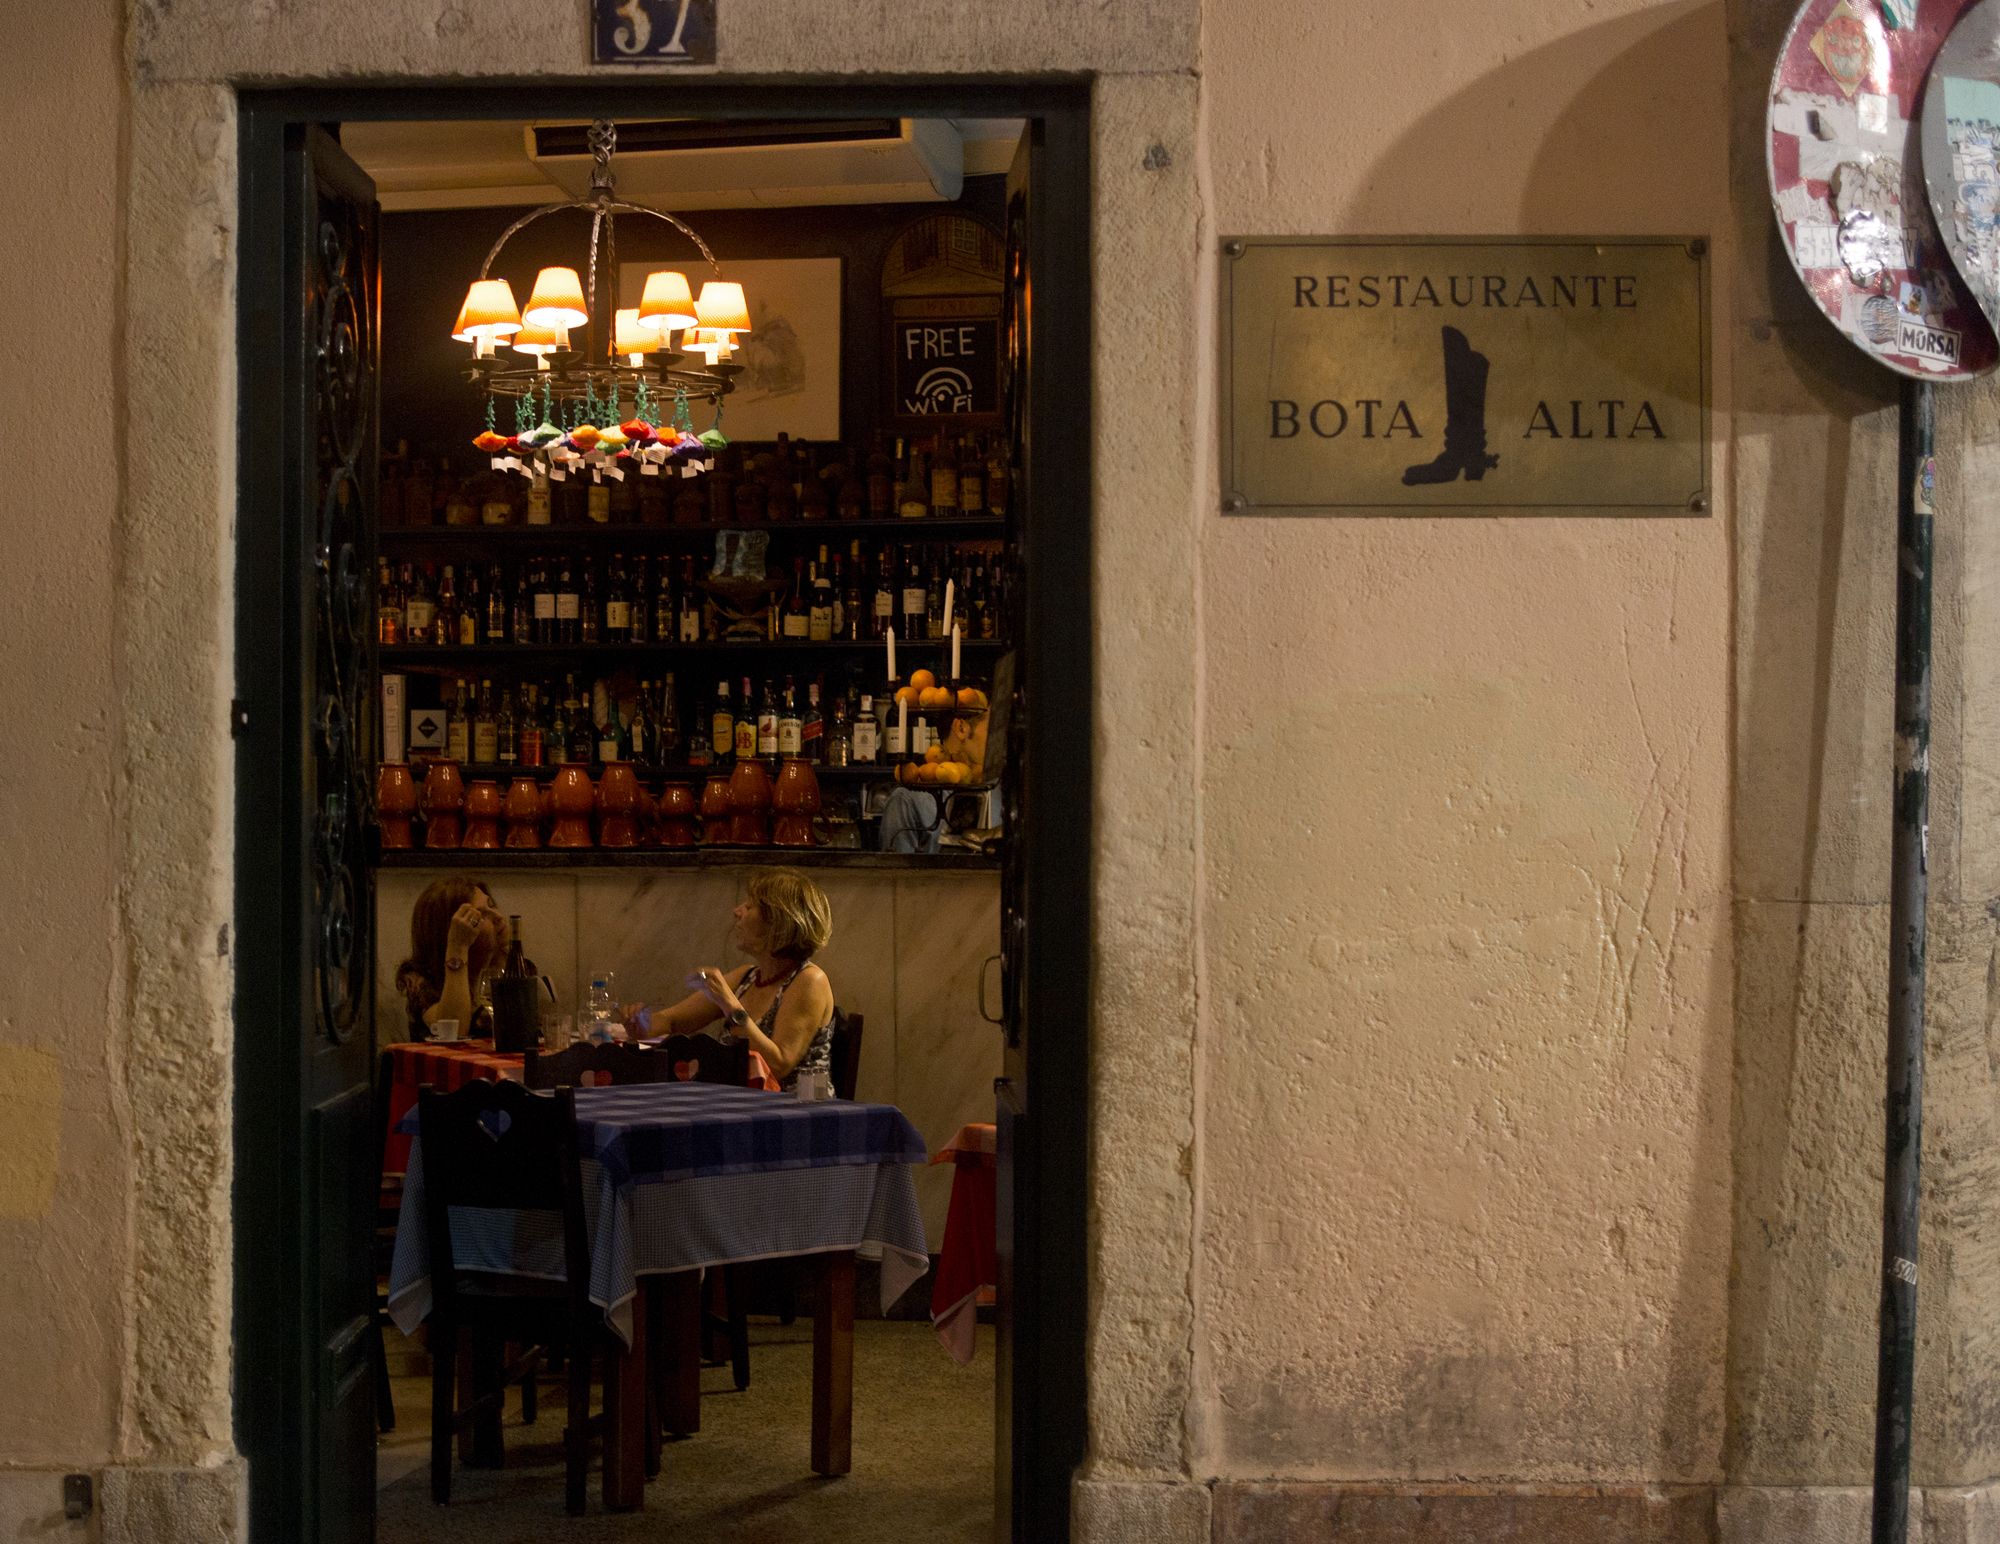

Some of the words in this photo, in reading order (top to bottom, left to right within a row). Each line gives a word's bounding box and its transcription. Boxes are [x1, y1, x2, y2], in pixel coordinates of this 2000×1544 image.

[613, 0, 690, 54] 37
[1292, 275, 1639, 308] RESTAURANTE
[906, 327, 976, 360] FREE
[1901, 326, 1955, 359] MORSA
[1268, 400, 1423, 439] BOTA
[1522, 400, 1668, 439] ALTA
